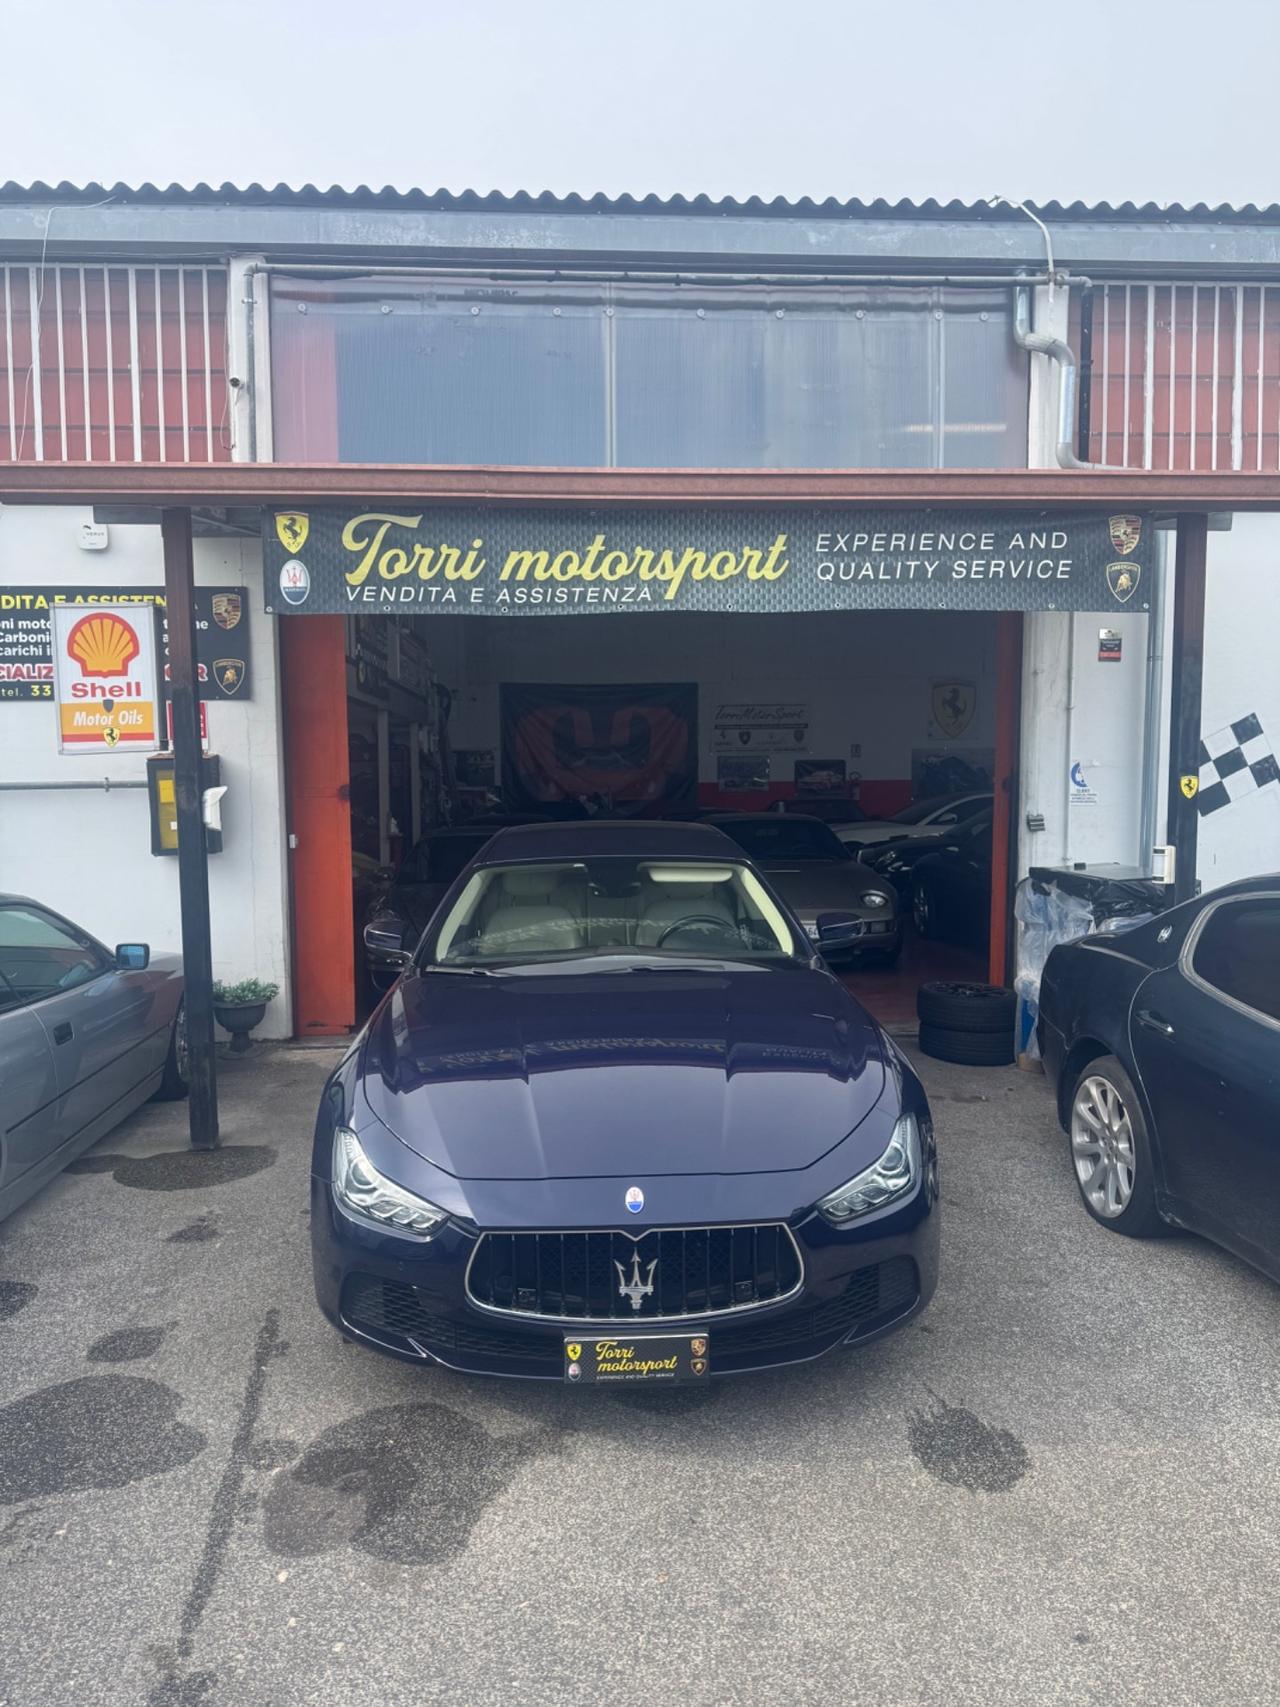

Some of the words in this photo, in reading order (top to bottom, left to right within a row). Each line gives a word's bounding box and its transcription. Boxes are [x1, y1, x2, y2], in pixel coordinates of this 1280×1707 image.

[816, 533, 995, 552] EXPERIENCE
[1009, 532, 1068, 551] AND
[342, 513, 486, 586] Torri
[500, 535, 789, 600] motorsport
[817, 560, 940, 581] QUALITY
[951, 560, 1073, 579] SERVICE
[74, 595, 167, 607] ASSISTEN
[346, 586, 457, 602] VENDITA
[470, 588, 485, 602] E
[496, 587, 652, 603] ASSISTENZA
[72, 682, 141, 698] Shell
[74, 711, 113, 727] Motor
[118, 709, 144, 725] Oils
[595, 1341, 635, 1361] Torri
[597, 1355, 678, 1376] motorsport
